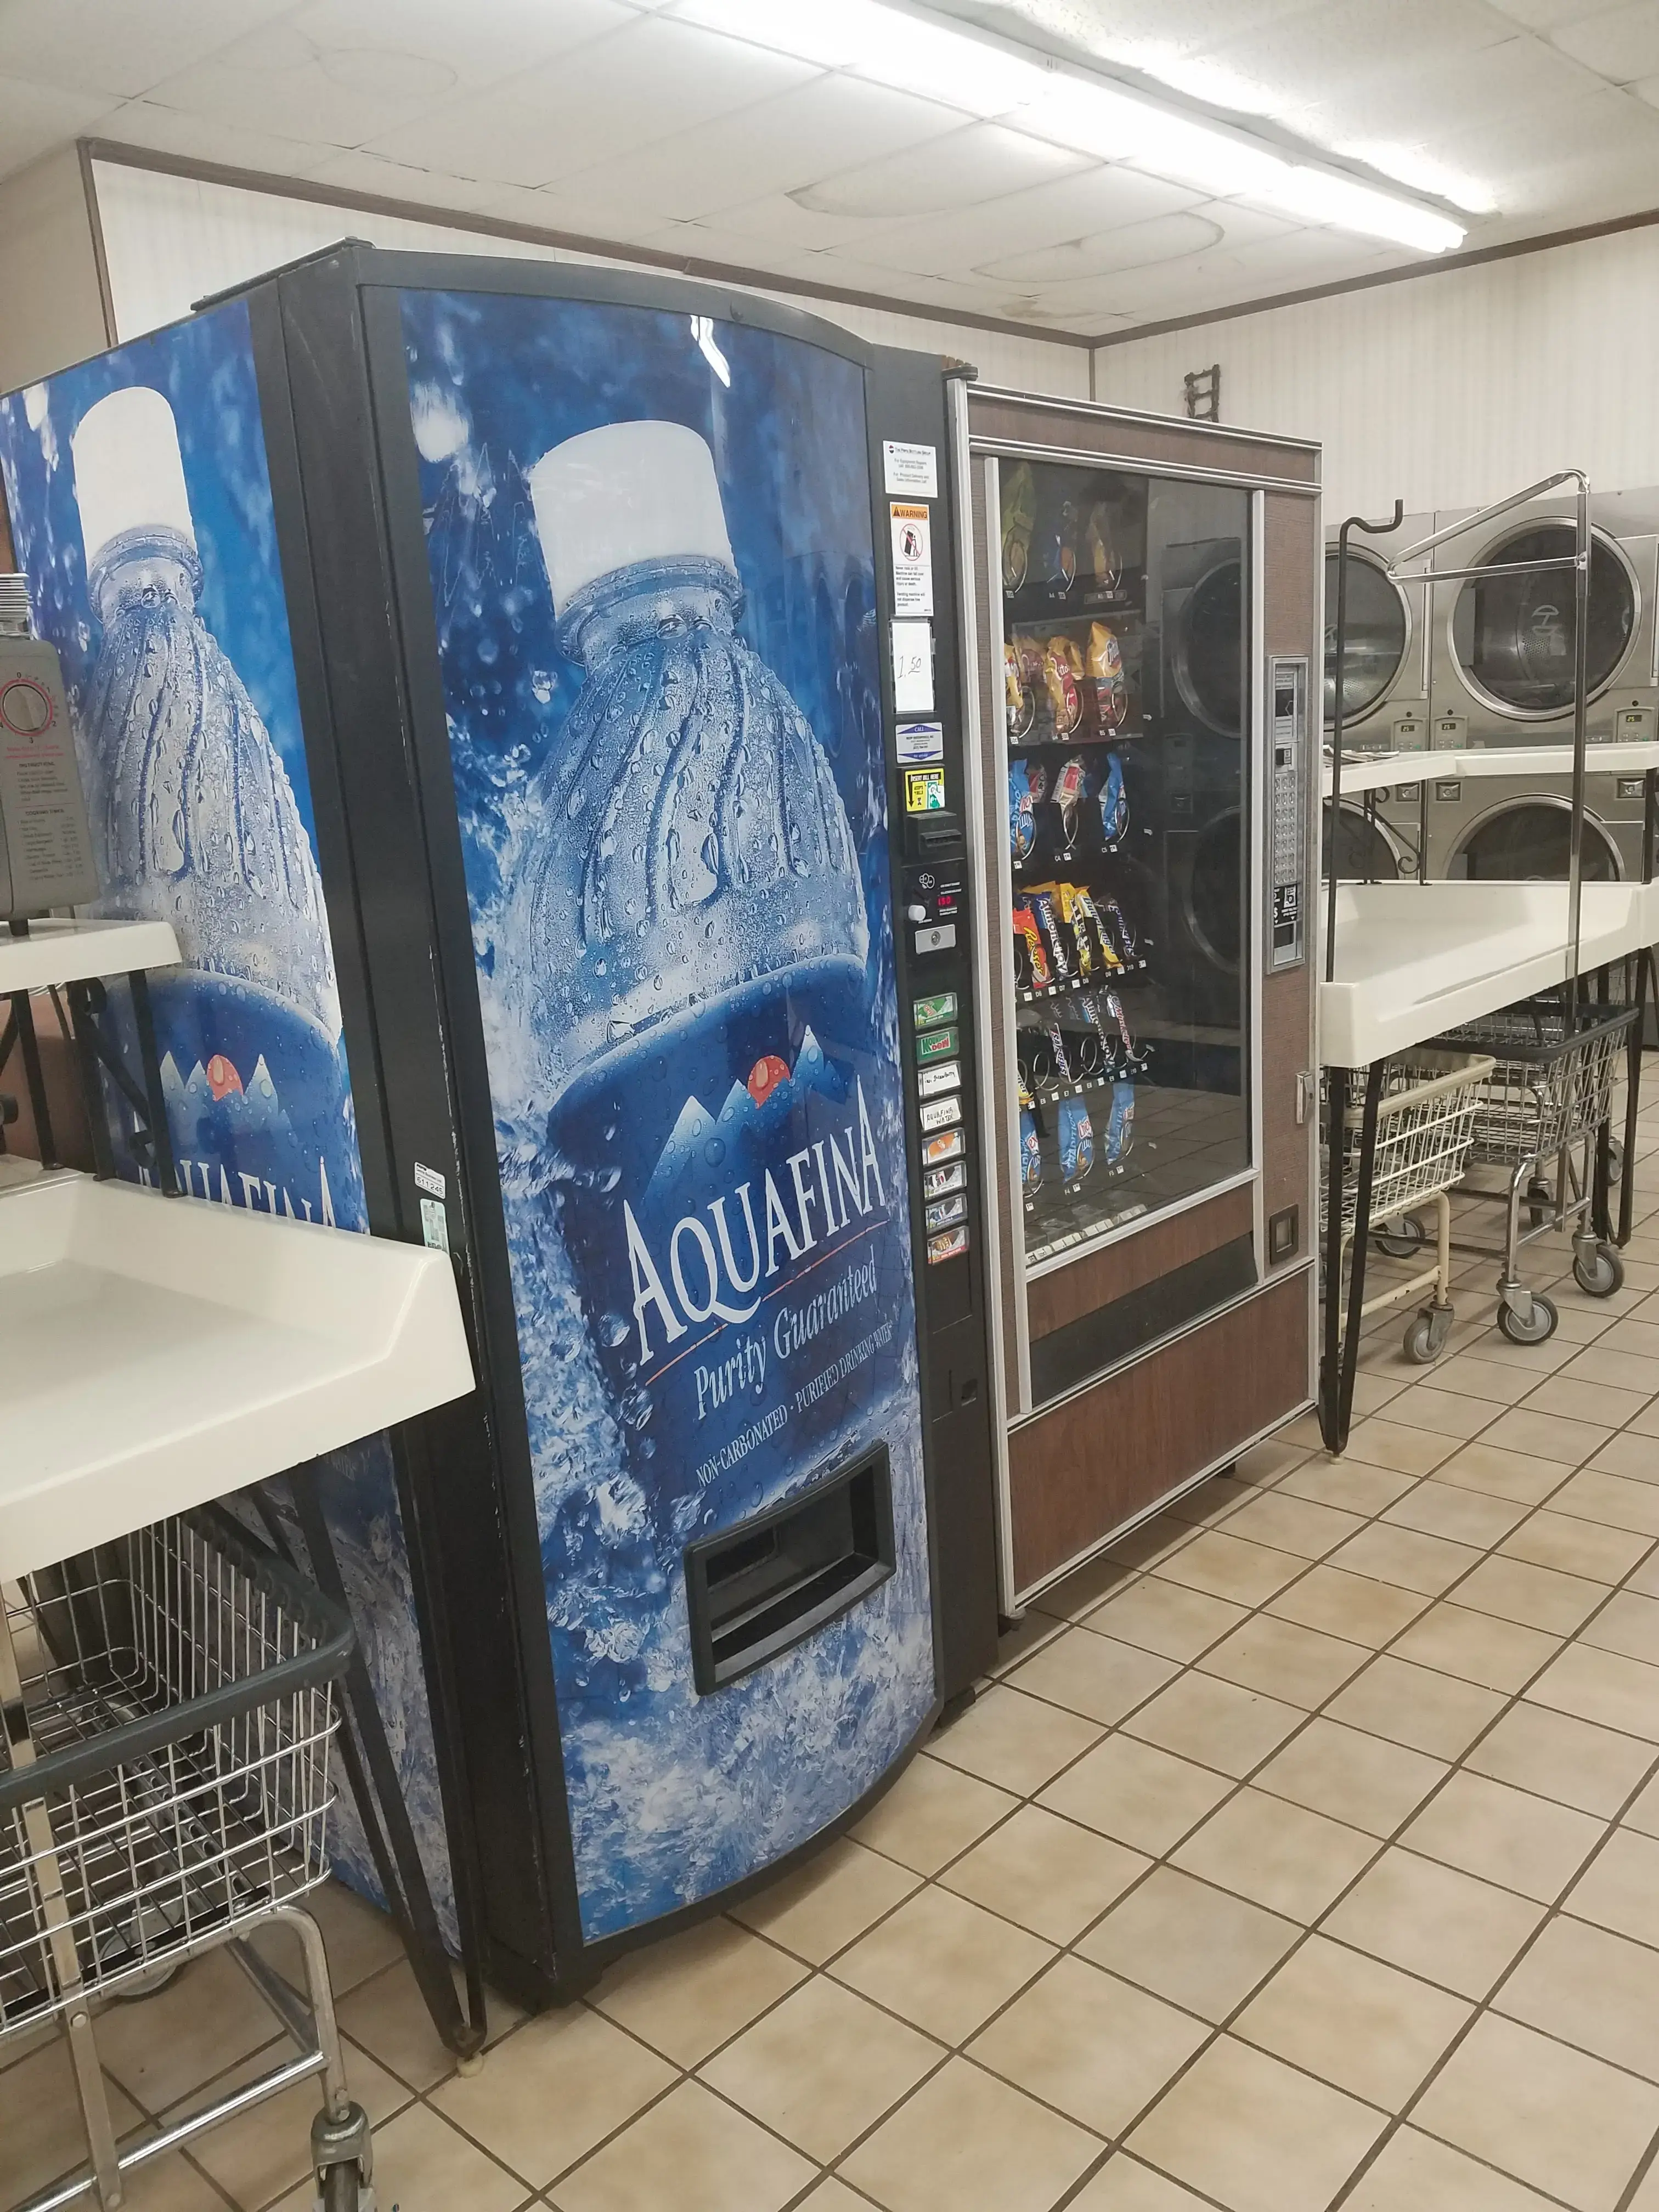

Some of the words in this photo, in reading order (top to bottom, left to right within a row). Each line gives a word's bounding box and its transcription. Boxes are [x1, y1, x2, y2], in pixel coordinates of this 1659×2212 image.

[900, 509, 927, 518] WARNING
[417, 1176, 443, 1195] 611245
[623, 1074, 885, 1366] AQUAFINA
[694, 1335, 766, 1420] Purity
[774, 1244, 877, 1359] Guaranteed
[696, 1404, 788, 1487] NON-CARBONATED
[795, 1363, 839, 1414] PURIFIED
[838, 1334, 874, 1379] DRINKING
